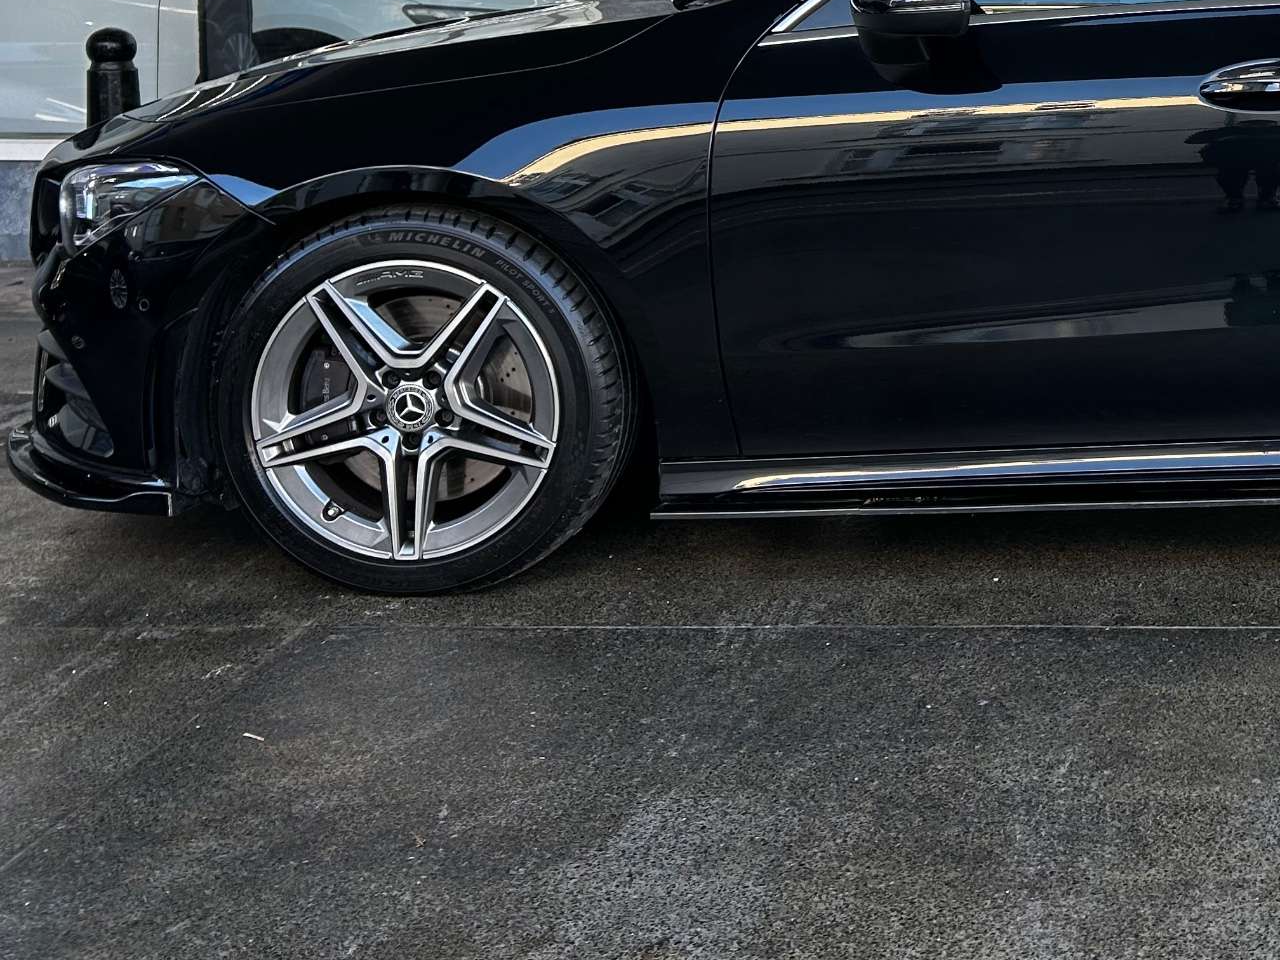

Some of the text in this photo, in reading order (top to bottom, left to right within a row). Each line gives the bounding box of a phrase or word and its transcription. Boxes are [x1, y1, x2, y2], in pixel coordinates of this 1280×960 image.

[388, 231, 486, 258] MICHELIN
[496, 259, 549, 307] PILOT SPORT
